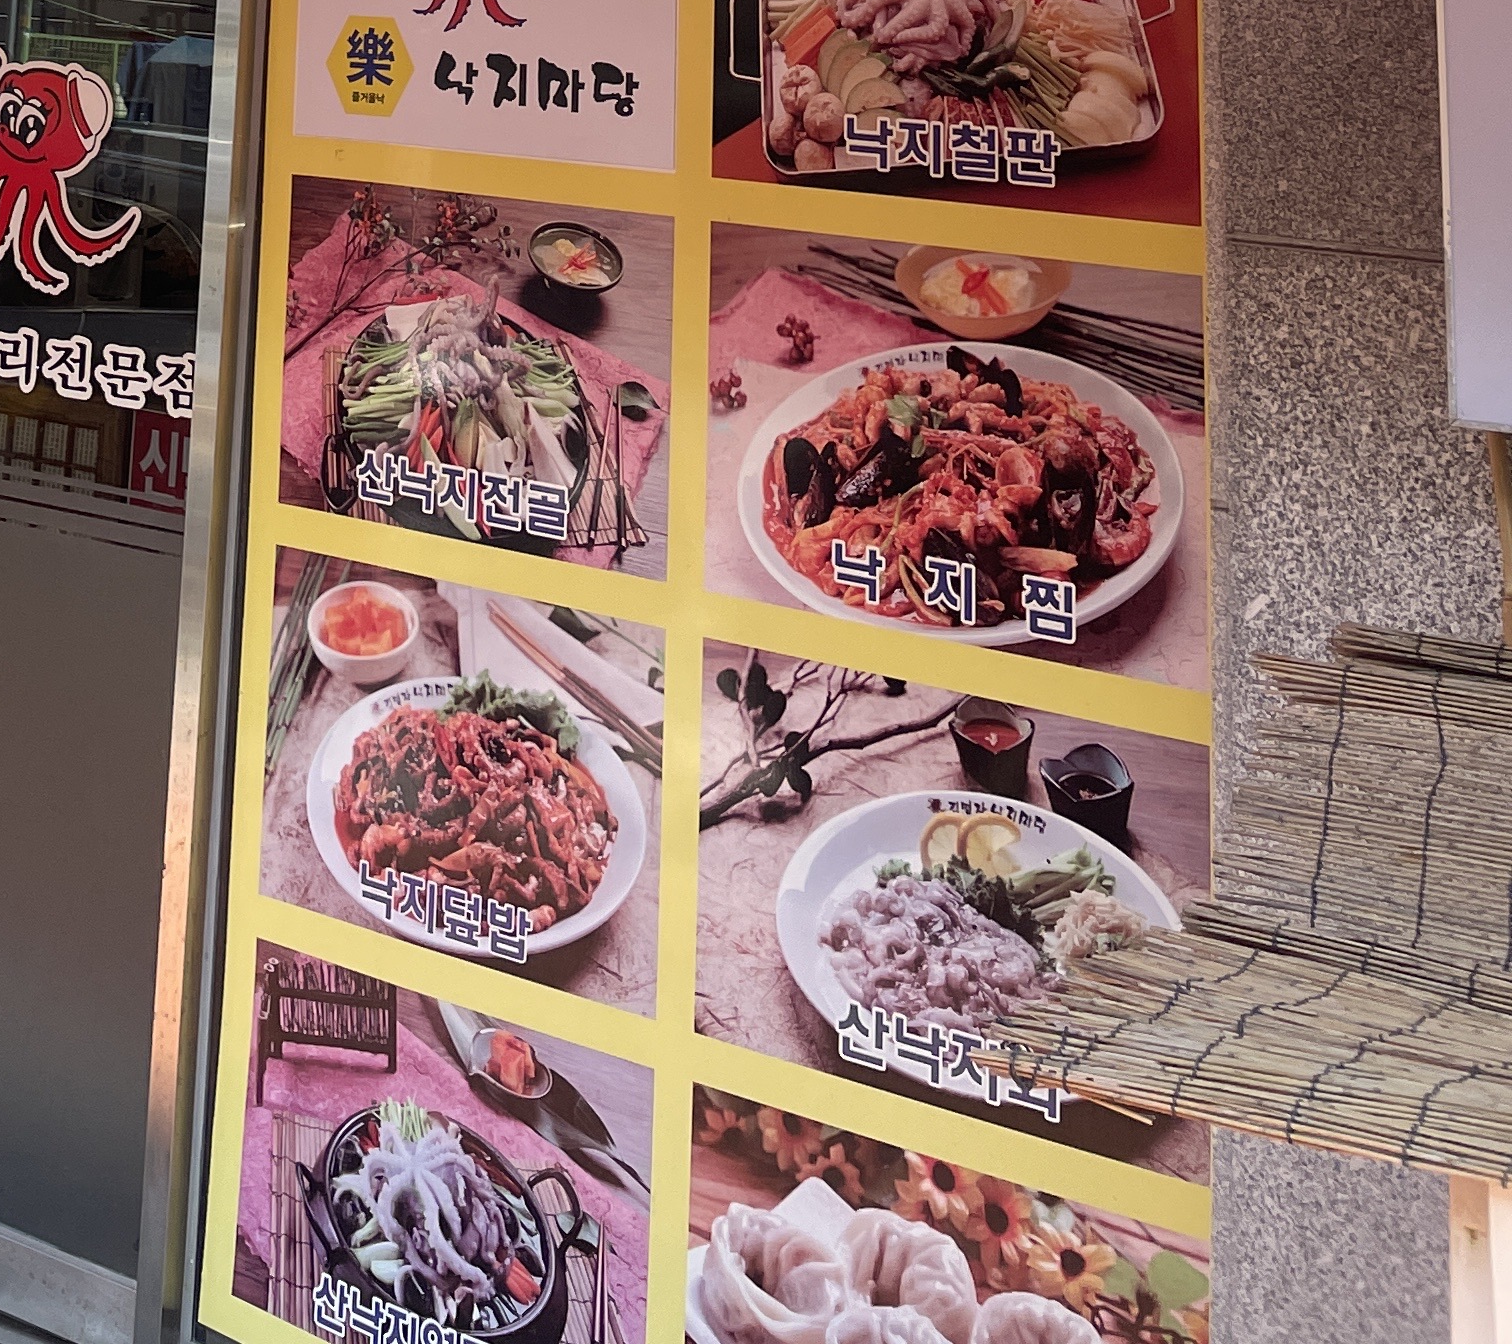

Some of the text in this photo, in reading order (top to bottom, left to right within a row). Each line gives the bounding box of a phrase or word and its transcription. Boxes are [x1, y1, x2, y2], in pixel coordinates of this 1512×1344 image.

[346, 27, 395, 86] 樂
[434, 50, 639, 117] 낙지마당
[843, 114, 1061, 188] 낙지철판
[356, 449, 570, 540] 산낙지전골
[359, 860, 534, 964] 낙지덮밥
[313, 1272, 488, 1344] 산낙지
